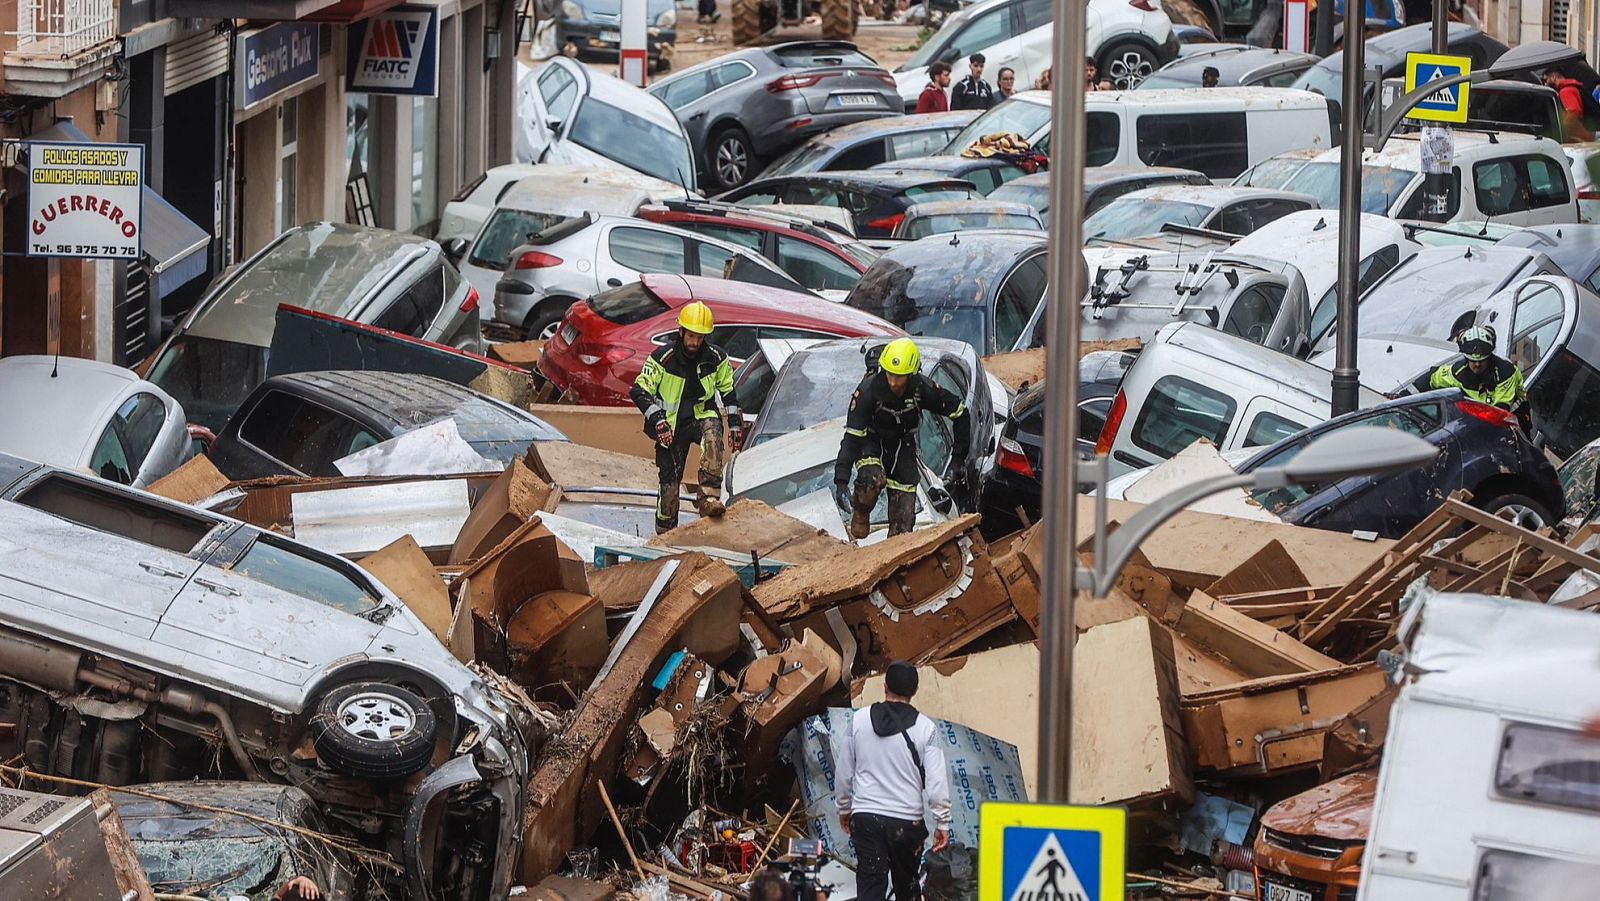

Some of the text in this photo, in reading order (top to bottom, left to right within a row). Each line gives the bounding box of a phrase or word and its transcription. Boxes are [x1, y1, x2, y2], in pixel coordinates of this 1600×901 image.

[363, 59, 410, 74] FIATC
[43, 149, 128, 166] POLLOS ASADOS Y
[33, 168, 138, 186] COMIDAS PARA LLEVAR
[32, 194, 137, 238] GUERRERO
[33, 244, 136, 255] Tel. 96 375 70 76
